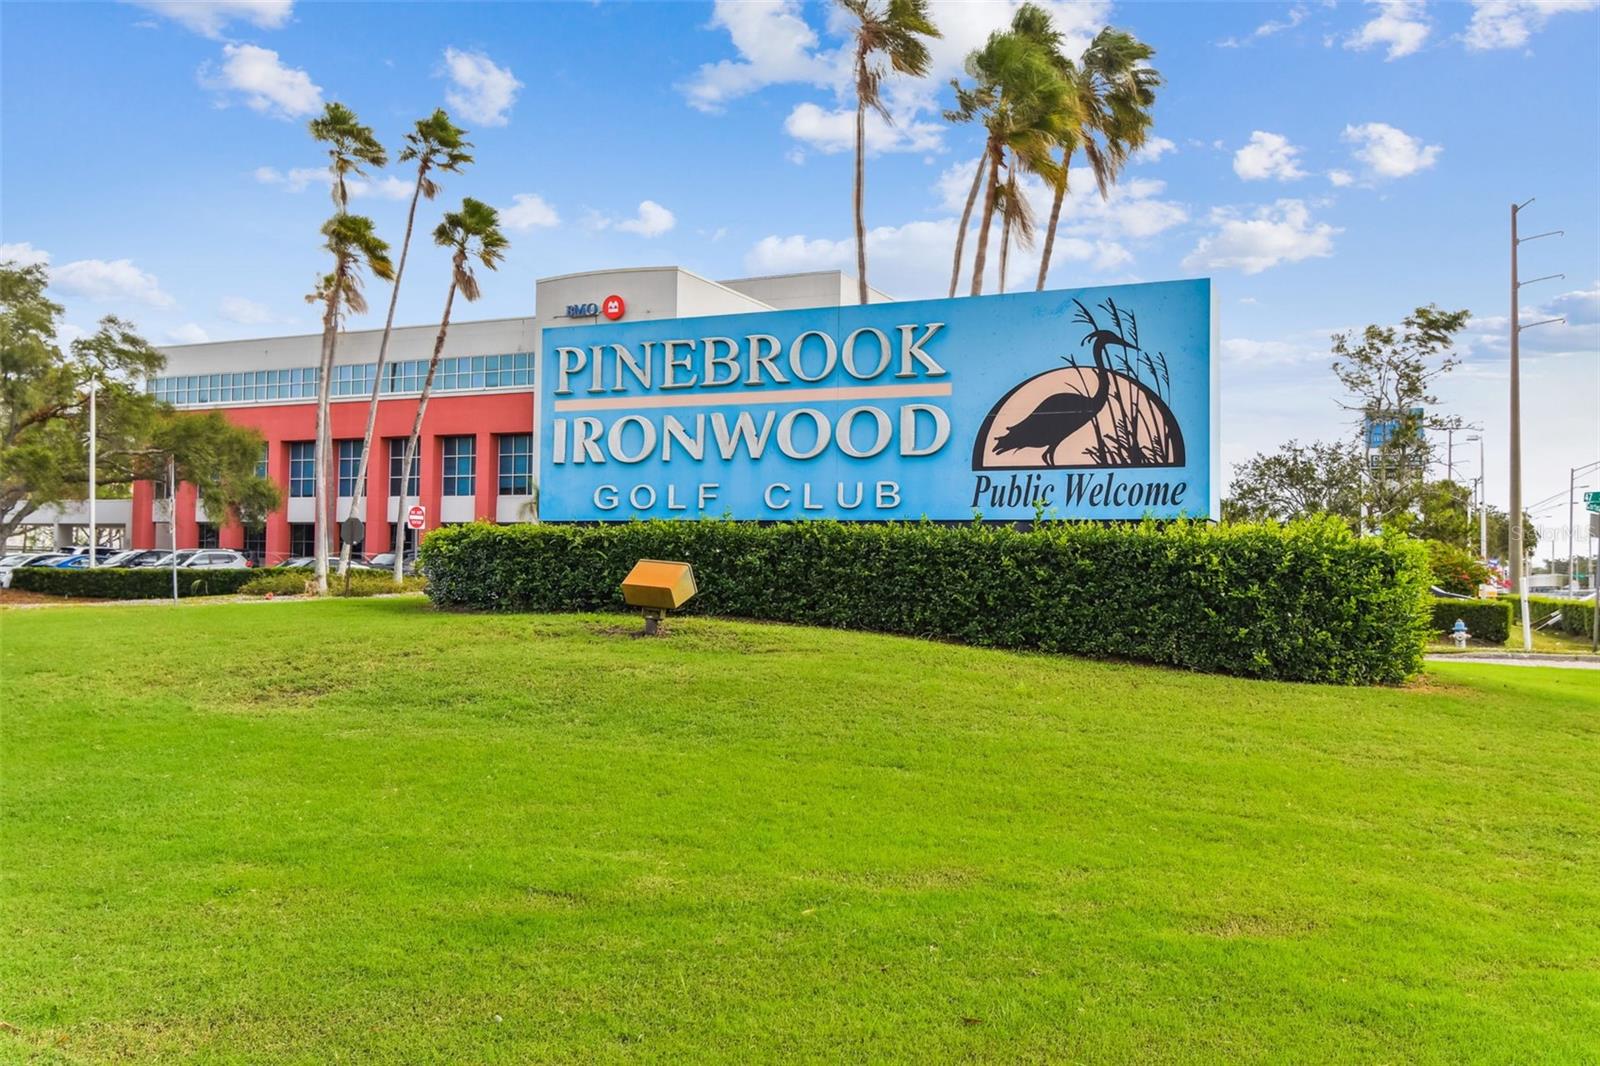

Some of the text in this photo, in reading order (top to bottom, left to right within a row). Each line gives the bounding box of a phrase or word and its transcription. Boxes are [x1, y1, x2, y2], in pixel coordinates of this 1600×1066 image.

[566, 303, 599, 318] BMO
[554, 323, 948, 395] PINEBROOK
[552, 404, 952, 464] IRONWOOD
[593, 481, 902, 511] GOLF CLUB
[971, 472, 1188, 508] Public Welcome
